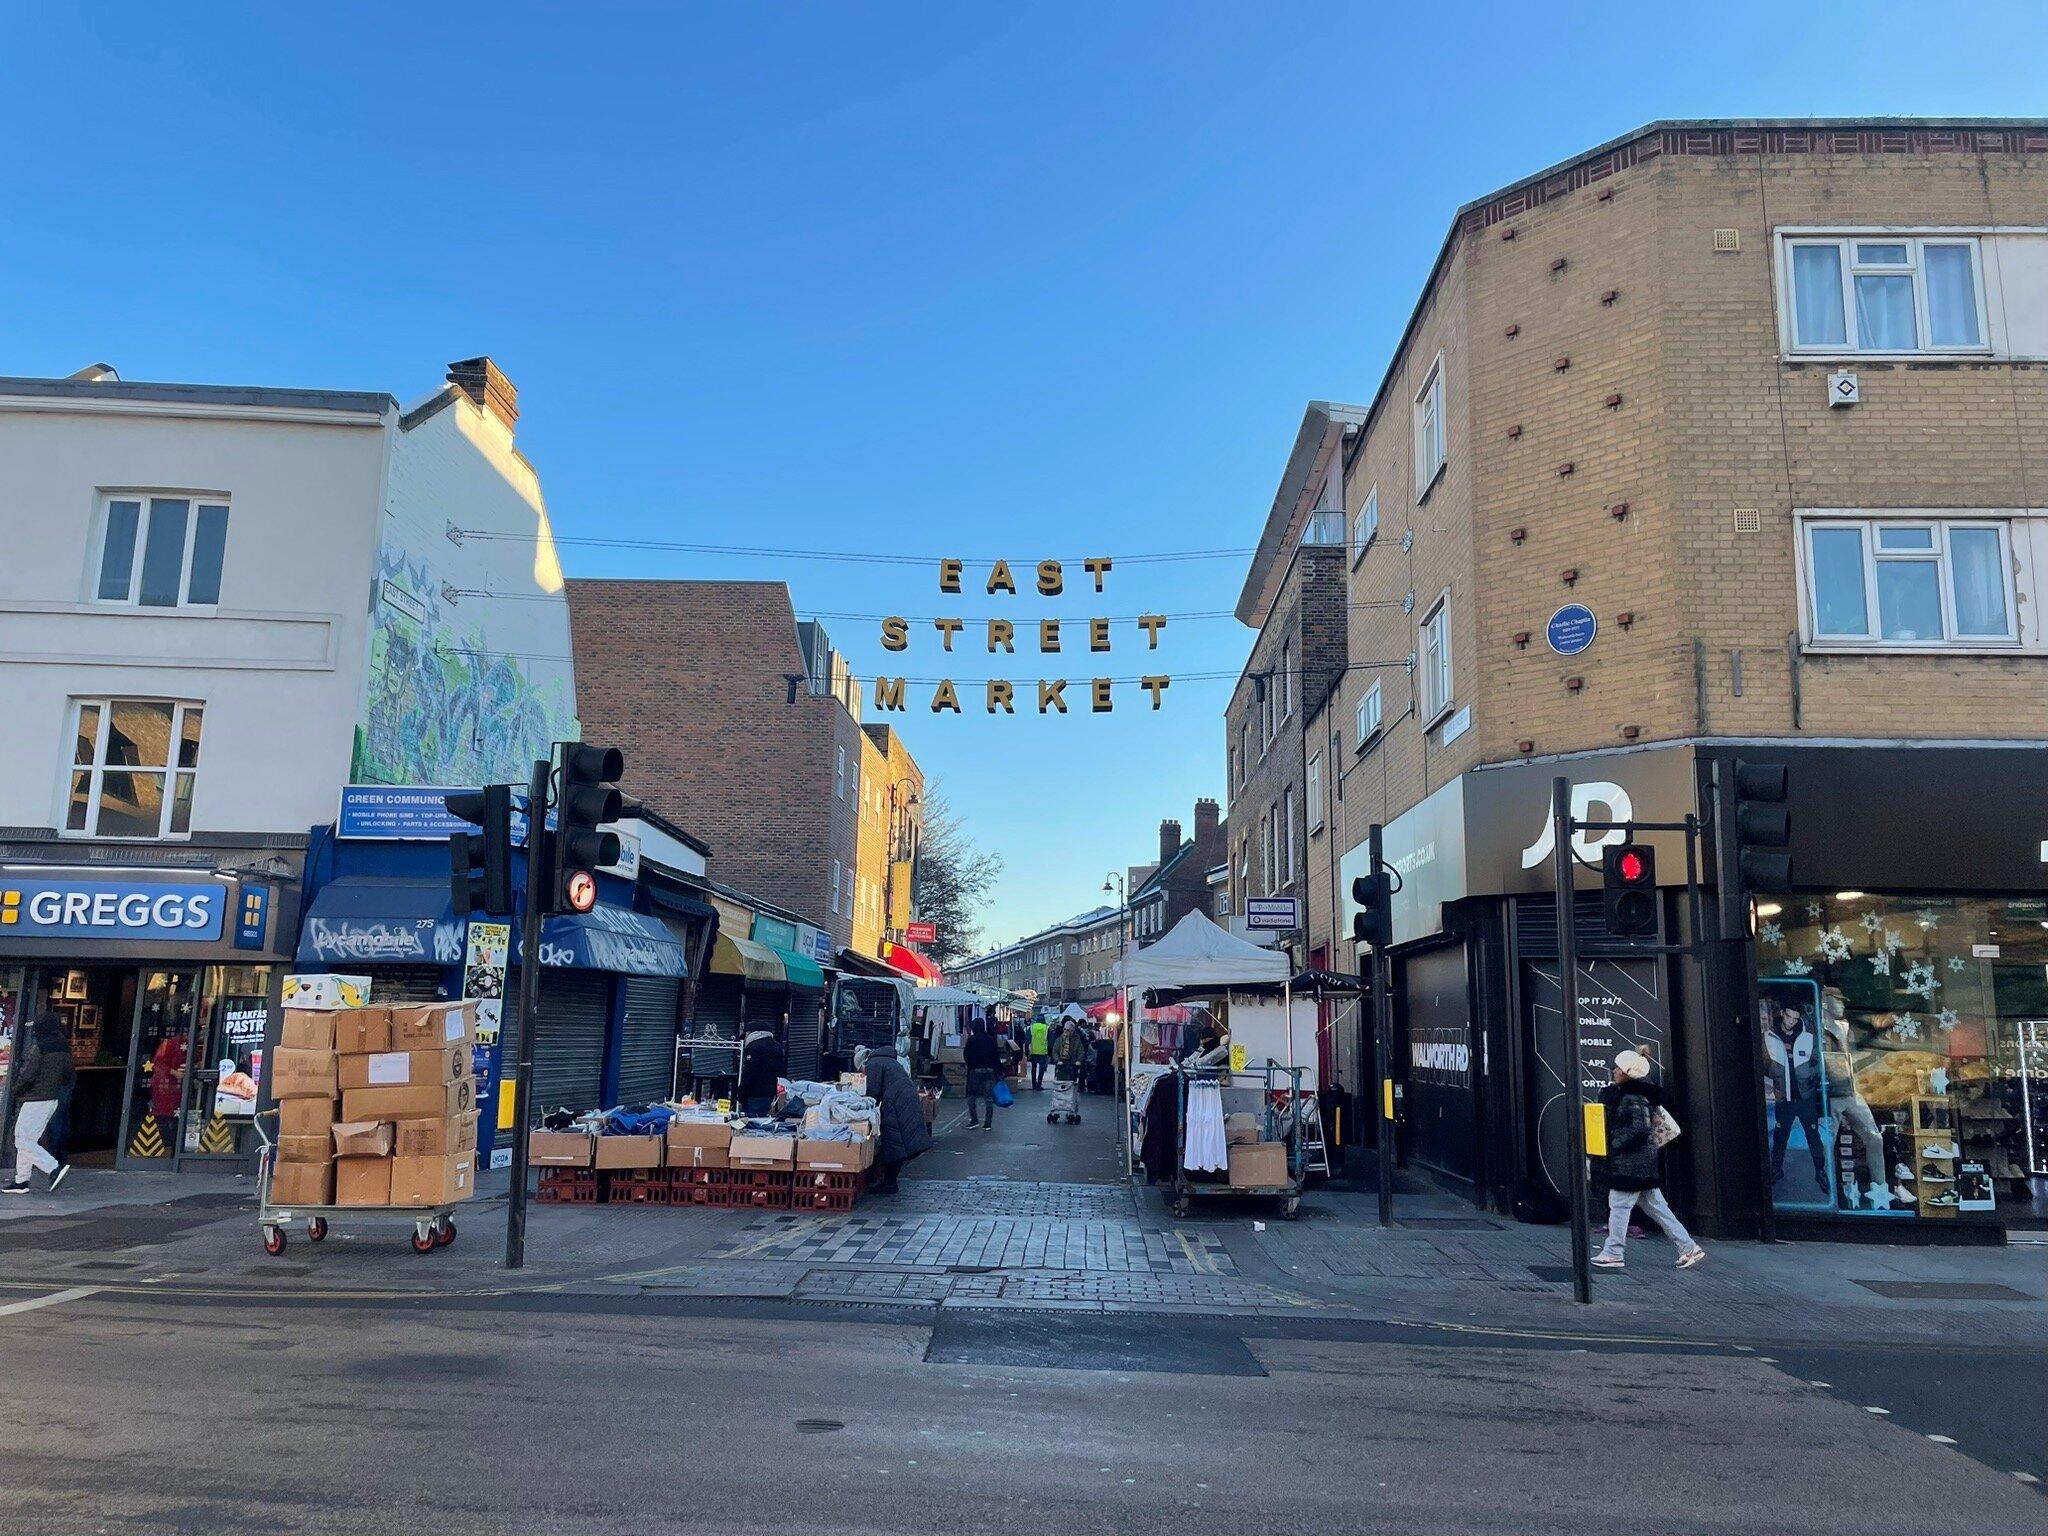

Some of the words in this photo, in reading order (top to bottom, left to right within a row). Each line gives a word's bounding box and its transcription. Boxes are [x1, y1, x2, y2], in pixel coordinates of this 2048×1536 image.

[939, 557, 1112, 596] EAST
[880, 615, 1167, 653] STREET
[874, 675, 1170, 714] MARKET
[347, 794, 383, 804] GREEN
[1522, 781, 1632, 869] JD
[30, 891, 210, 929] GREGGS
[415, 919, 435, 929] 275
[1591, 997, 1599, 1005] IT
[1602, 997, 1622, 1006] 24/7
[1579, 1018, 1612, 1026] ONLINE
[1580, 1038, 1613, 1047] MOBILE
[1412, 1041, 1457, 1071] WALWORTH
[1457, 1043, 1469, 1072] RD
[1588, 1059, 1606, 1067] APP
